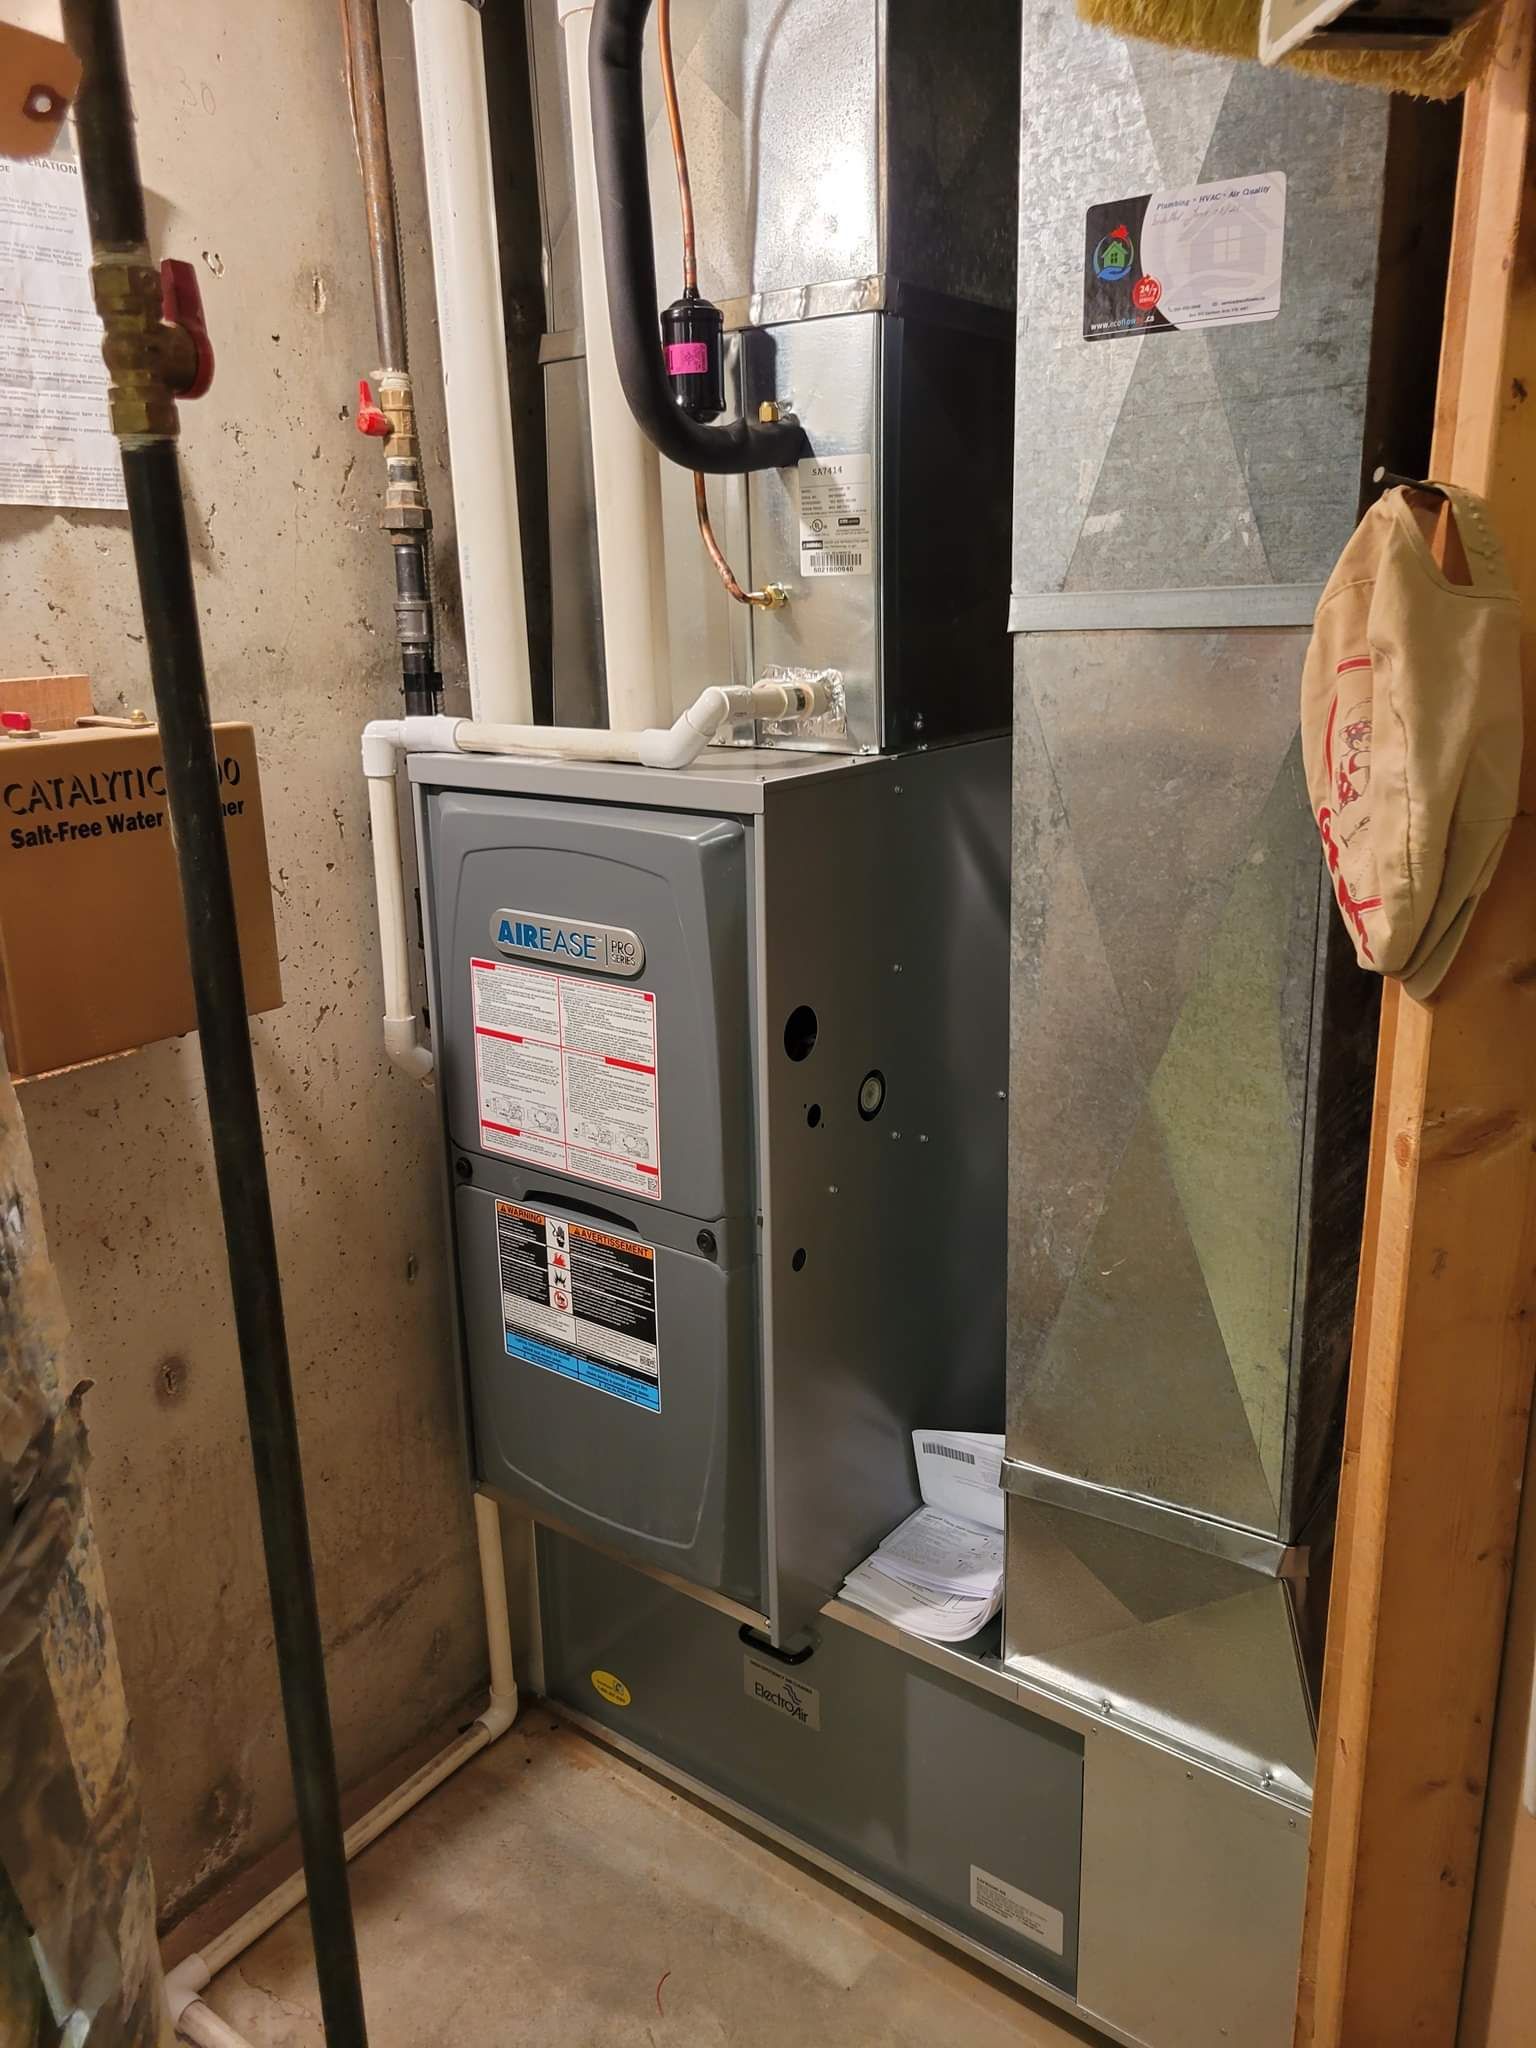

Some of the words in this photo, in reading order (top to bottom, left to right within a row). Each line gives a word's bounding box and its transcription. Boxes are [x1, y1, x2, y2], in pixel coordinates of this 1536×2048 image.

[1156, 200, 1190, 210] Plumbing
[1199, 192, 1222, 203] HVAC
[1229, 187, 1241, 198] Air
[1242, 185, 1271, 196] Quality
[1139, 283, 1158, 297] 24/7
[812, 465, 843, 476] SA7414
[3, 765, 167, 816] CATALYTIC
[11, 820, 102, 849] Salt-Free
[107, 811, 164, 835] Water
[498, 919, 598, 960] AIREASE
[611, 940, 636, 956] PRO
[611, 953, 636, 967] SERIES
[507, 1206, 543, 1225] WARNING
[581, 1229, 649, 1257] AVERTISSEMENT
